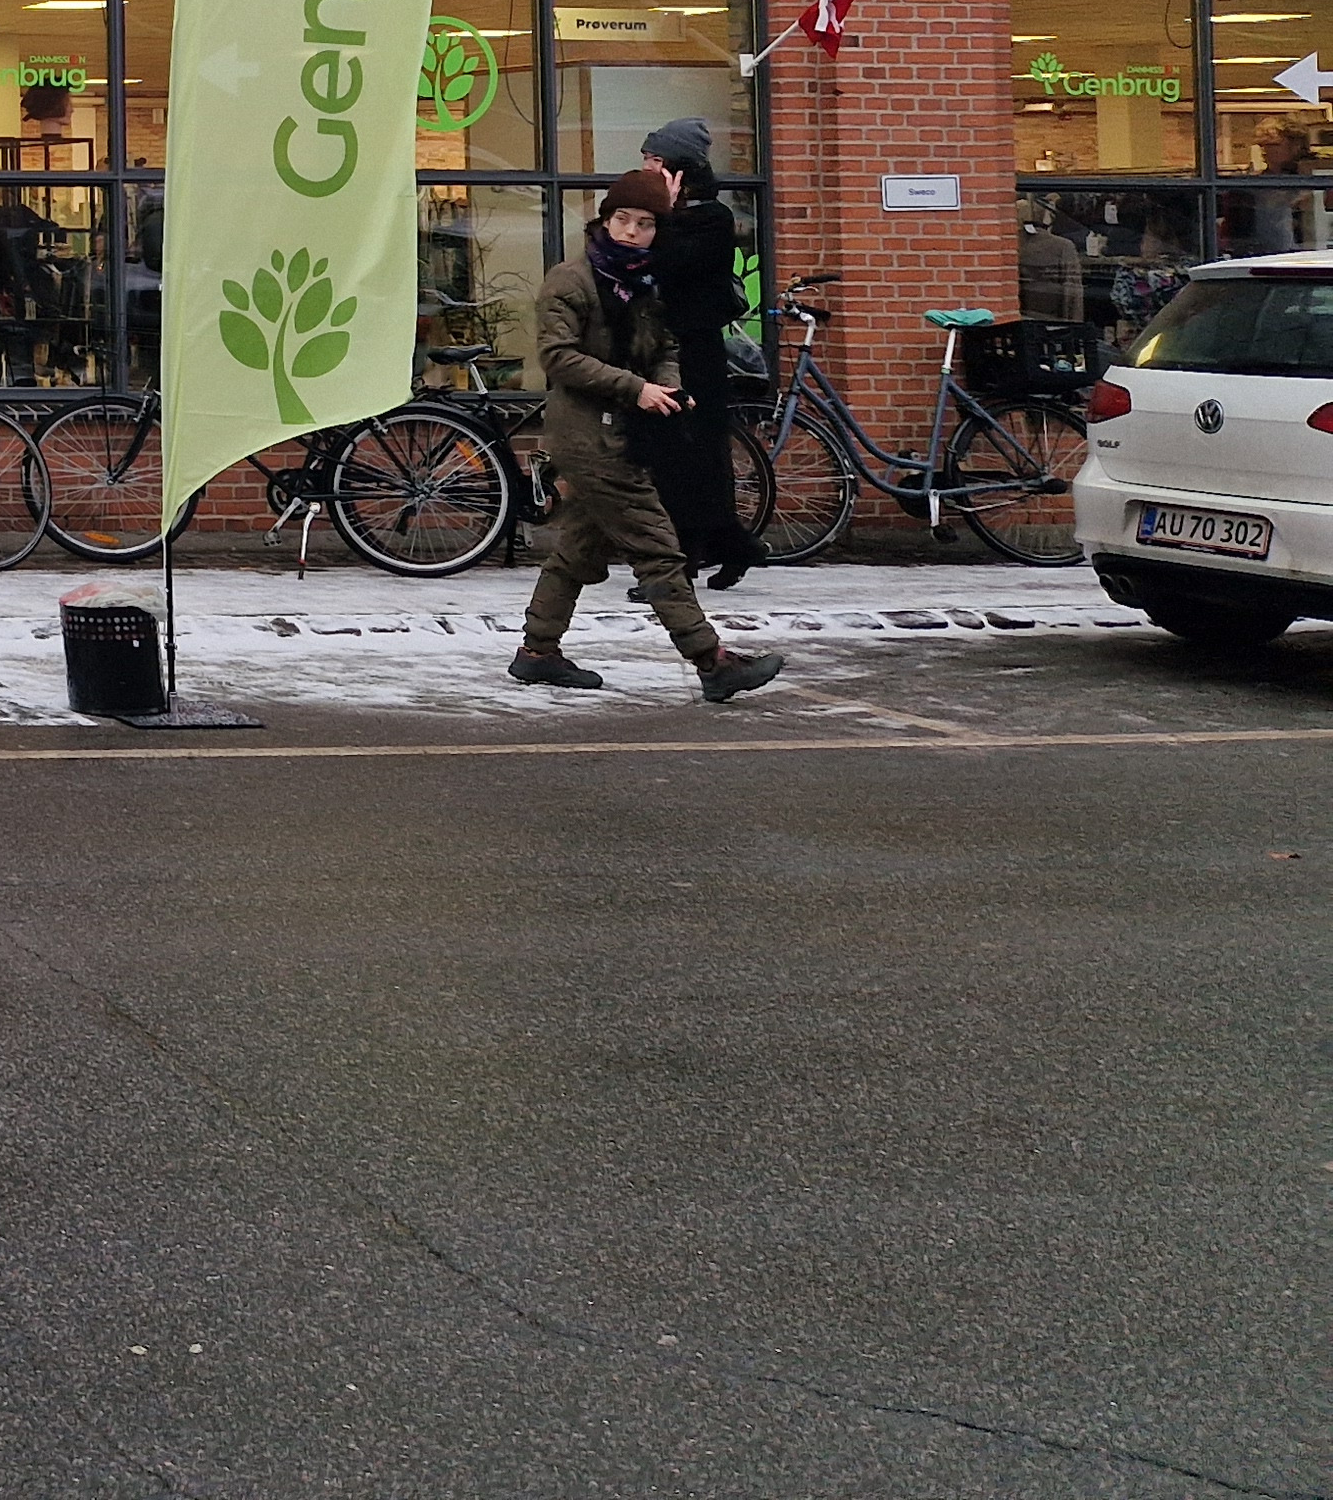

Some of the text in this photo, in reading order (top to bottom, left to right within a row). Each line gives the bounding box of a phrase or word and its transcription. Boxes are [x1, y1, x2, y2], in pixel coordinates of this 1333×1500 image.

[576, 18, 647, 31] Prøverum
[29, 55, 86, 66] DANMISSION
[1063, 71, 1181, 103] Genbrug
[1154, 512, 1264, 548] AU 70 302
